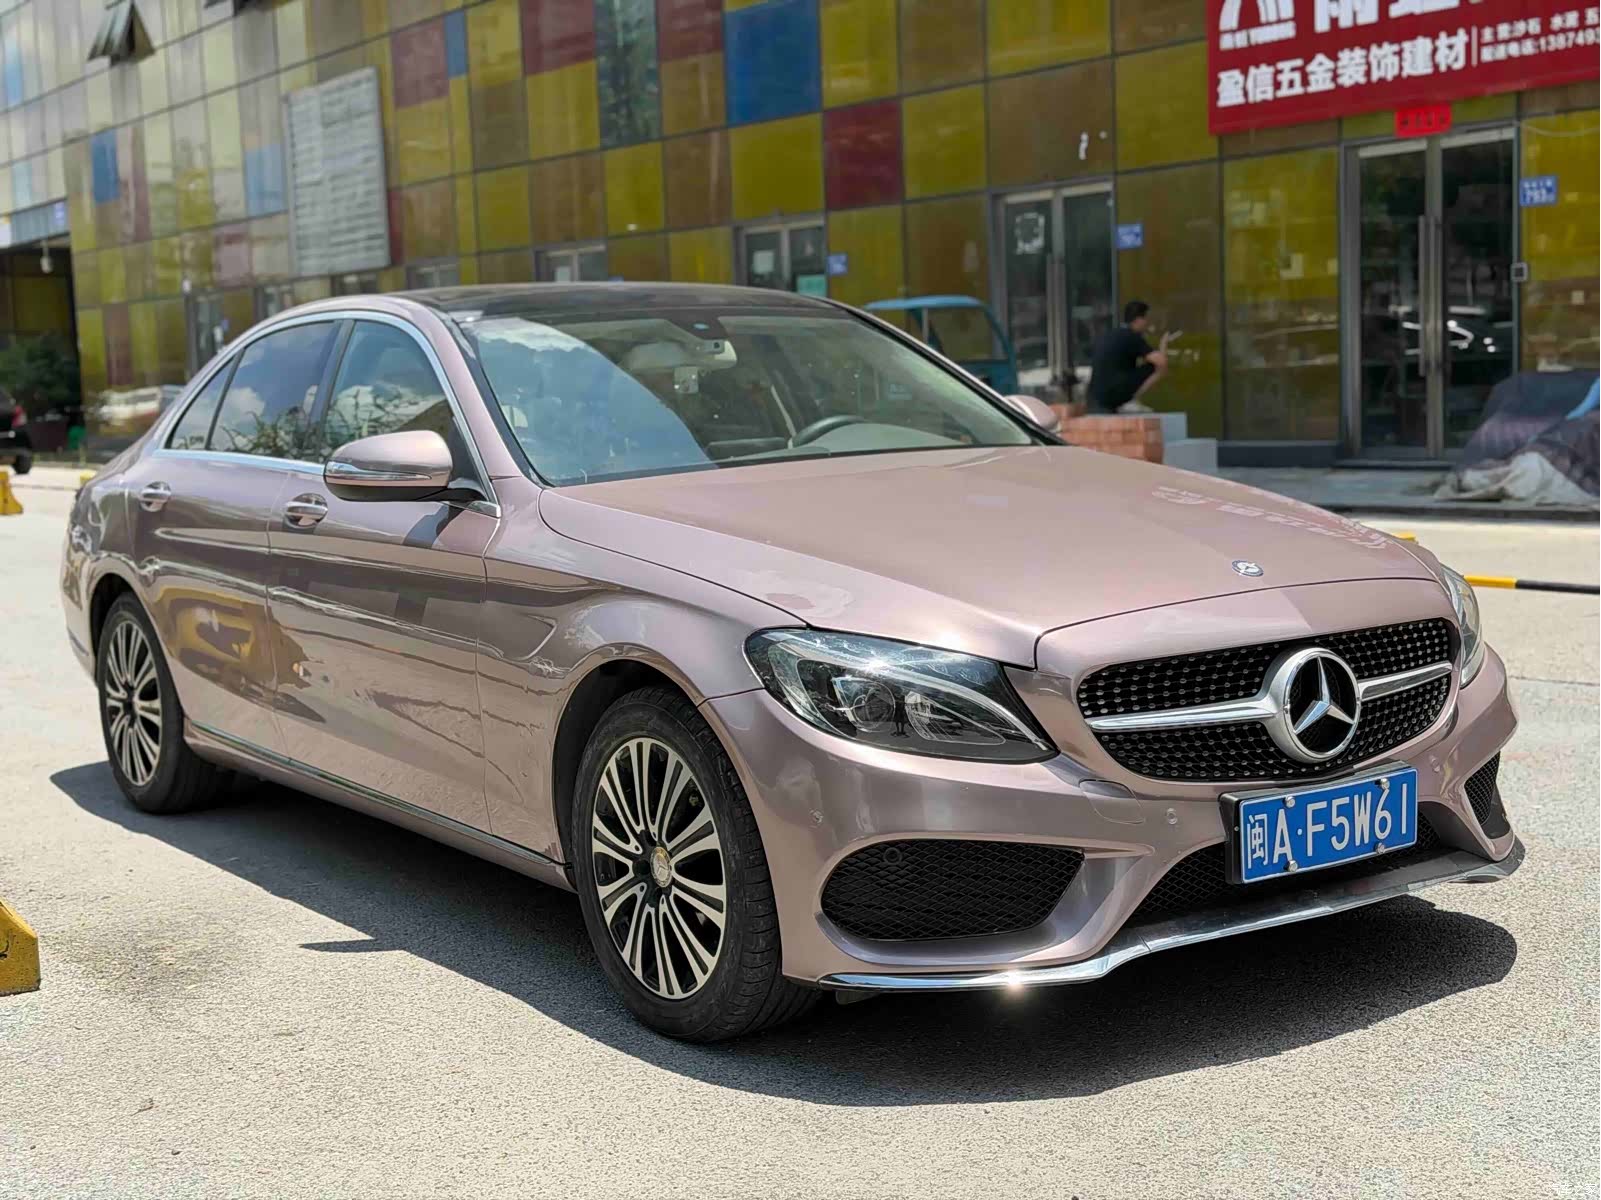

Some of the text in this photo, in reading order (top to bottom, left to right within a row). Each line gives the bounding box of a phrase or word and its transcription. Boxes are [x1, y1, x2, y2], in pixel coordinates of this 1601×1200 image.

[1217, 28, 1469, 107] 盈信五金装饰建材
